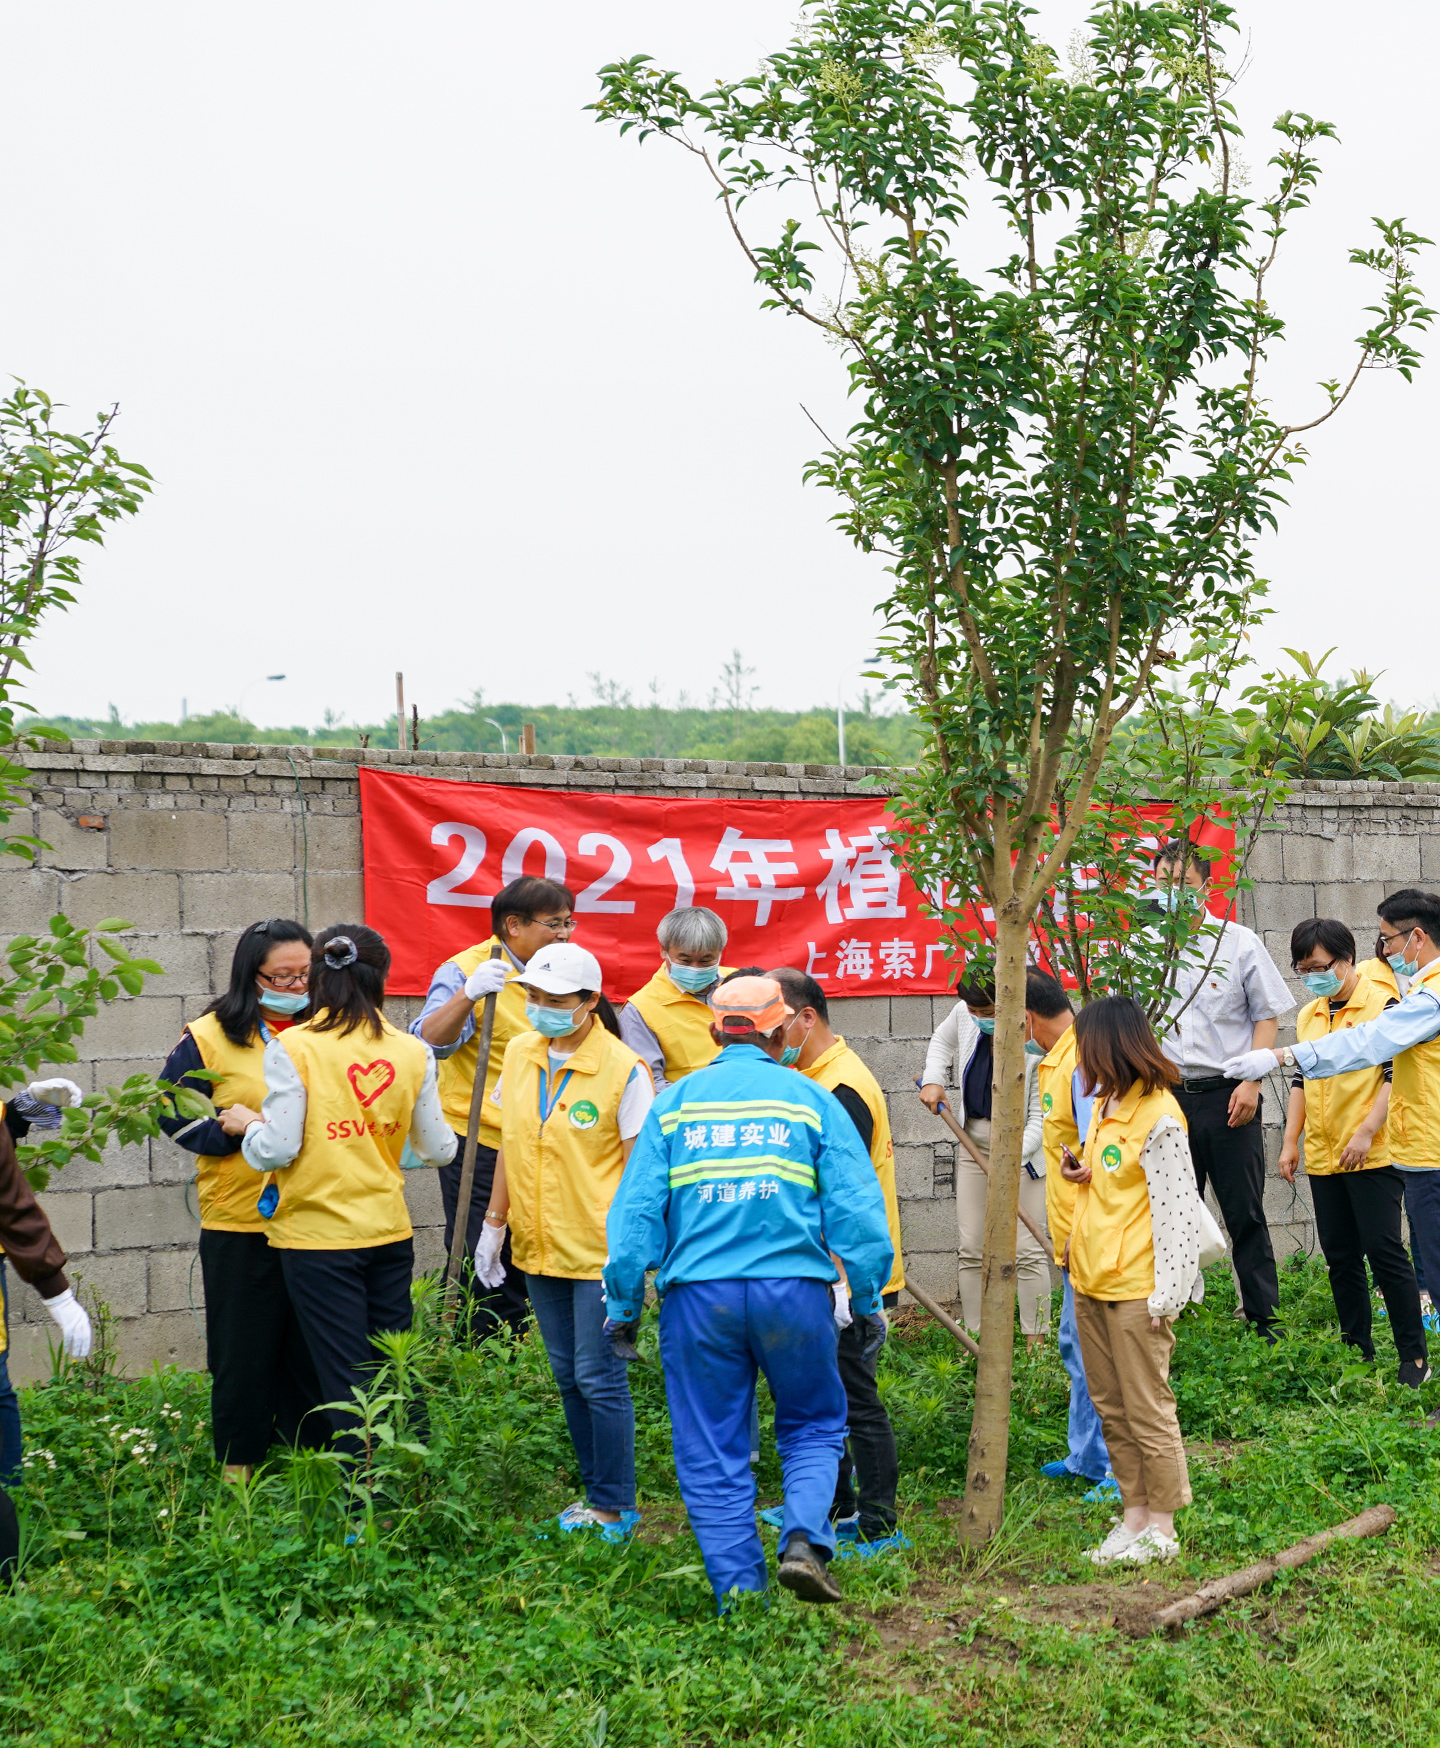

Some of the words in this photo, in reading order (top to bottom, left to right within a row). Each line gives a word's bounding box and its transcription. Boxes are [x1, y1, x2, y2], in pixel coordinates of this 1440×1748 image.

[427, 822, 1172, 925] 2021年植
[683, 1122, 791, 1151] 城建实业
[697, 1180, 780, 1204] 河道养护
